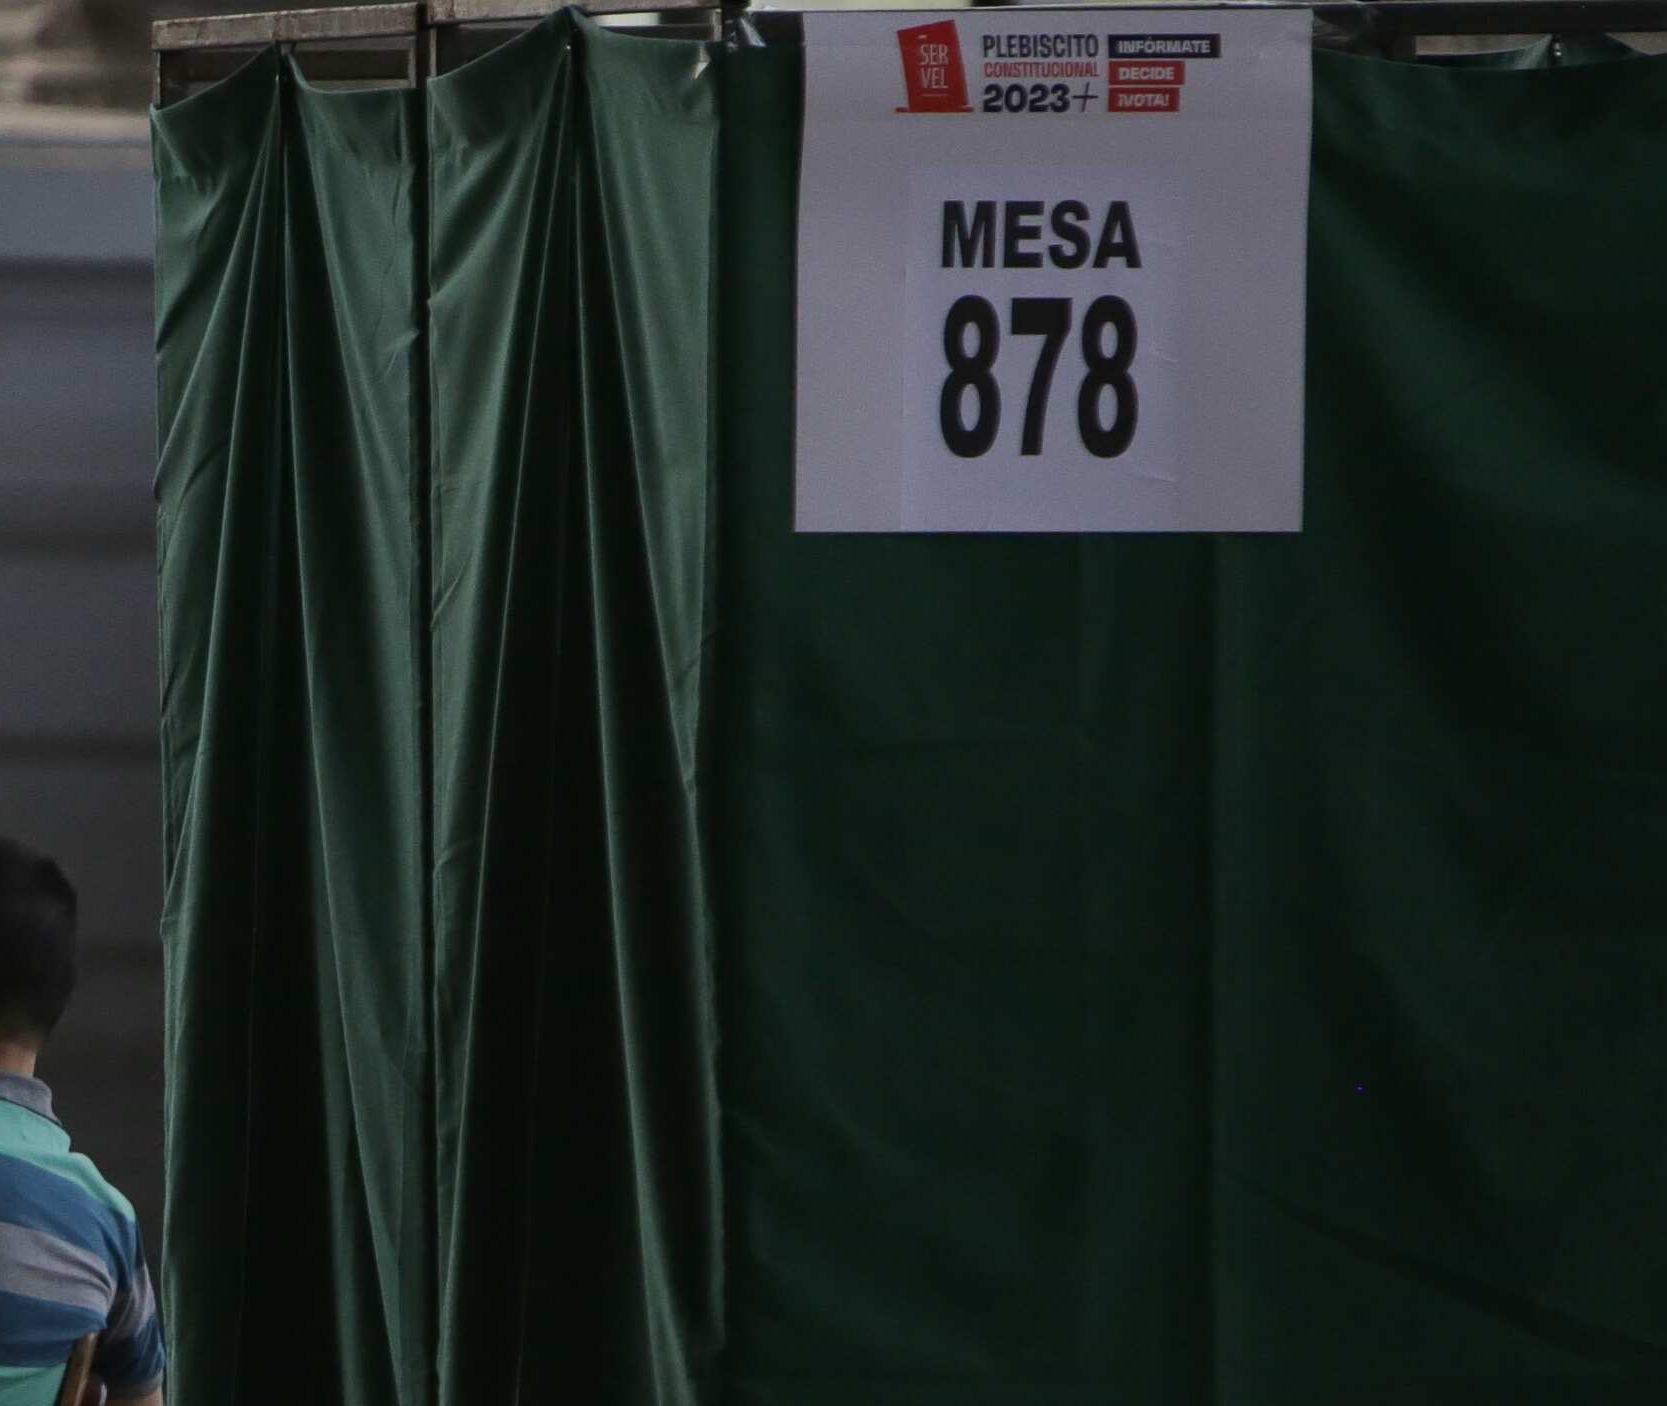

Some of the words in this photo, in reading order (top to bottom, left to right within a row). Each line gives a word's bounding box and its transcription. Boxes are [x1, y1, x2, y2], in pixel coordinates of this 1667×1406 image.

[918, 43, 949, 66] SER
[981, 33, 1100, 59] PLEBISCITO
[1117, 36, 1211, 54] INFÓRMATE
[919, 67, 948, 90] VEL
[983, 61, 1099, 79] CONSTITUCIONAL
[1118, 66, 1175, 81] DECIDE
[1117, 92, 1169, 108] ¡VOTA!
[941, 199, 1142, 270] MESA
[939, 294, 1138, 458] 878
